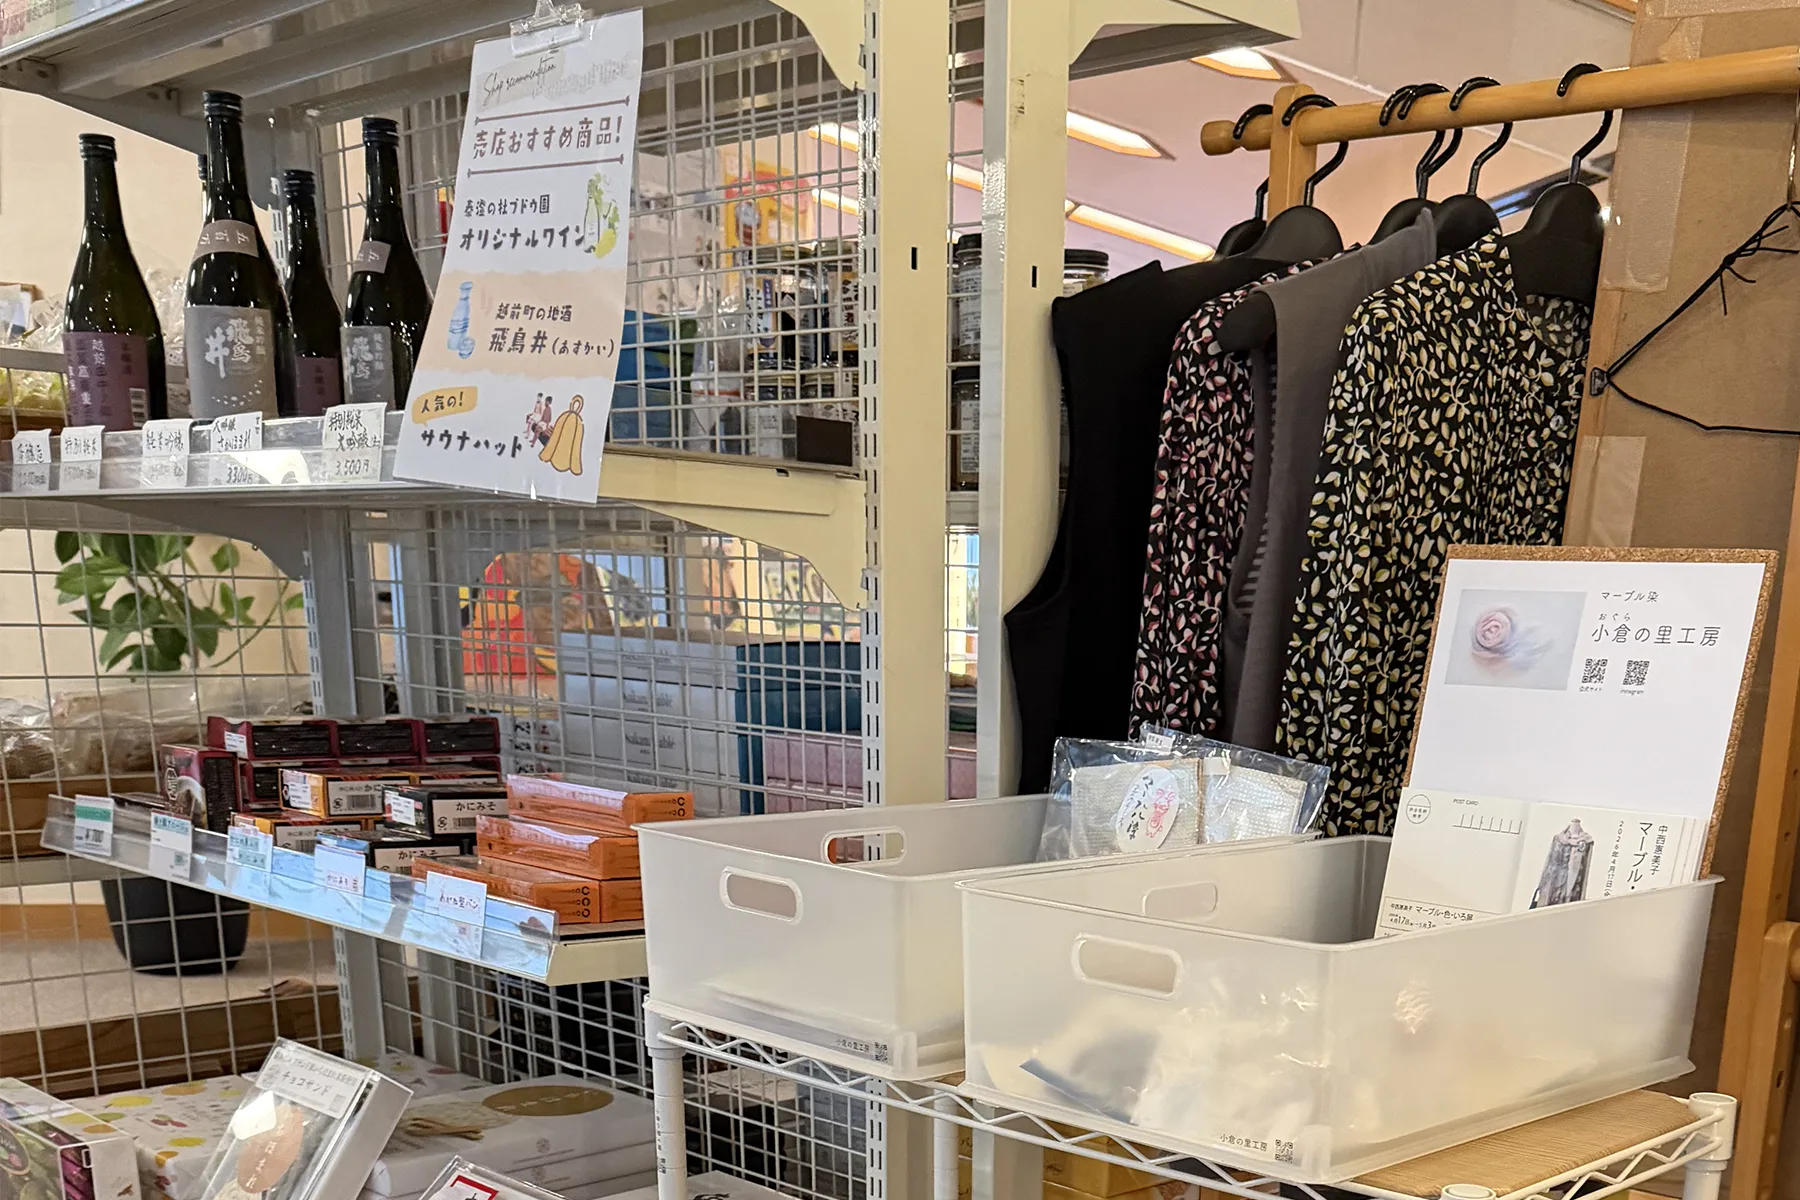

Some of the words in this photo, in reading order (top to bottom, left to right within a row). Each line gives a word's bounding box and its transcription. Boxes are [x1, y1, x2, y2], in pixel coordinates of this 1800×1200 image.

[460, 225, 585, 251] オリジナルワイン
[495, 302, 573, 323] 越前町の地酒
[421, 391, 464, 414] 人気の!
[421, 429, 523, 458] サウナハット
[1601, 590, 1659, 602] マーブル染
[1599, 613, 1631, 622] おぐら
[1591, 623, 1721, 647] 小倉の里工房
[456, 801, 497, 812] かにみそ
[1220, 1133, 1268, 1152] 小倉の里工房
